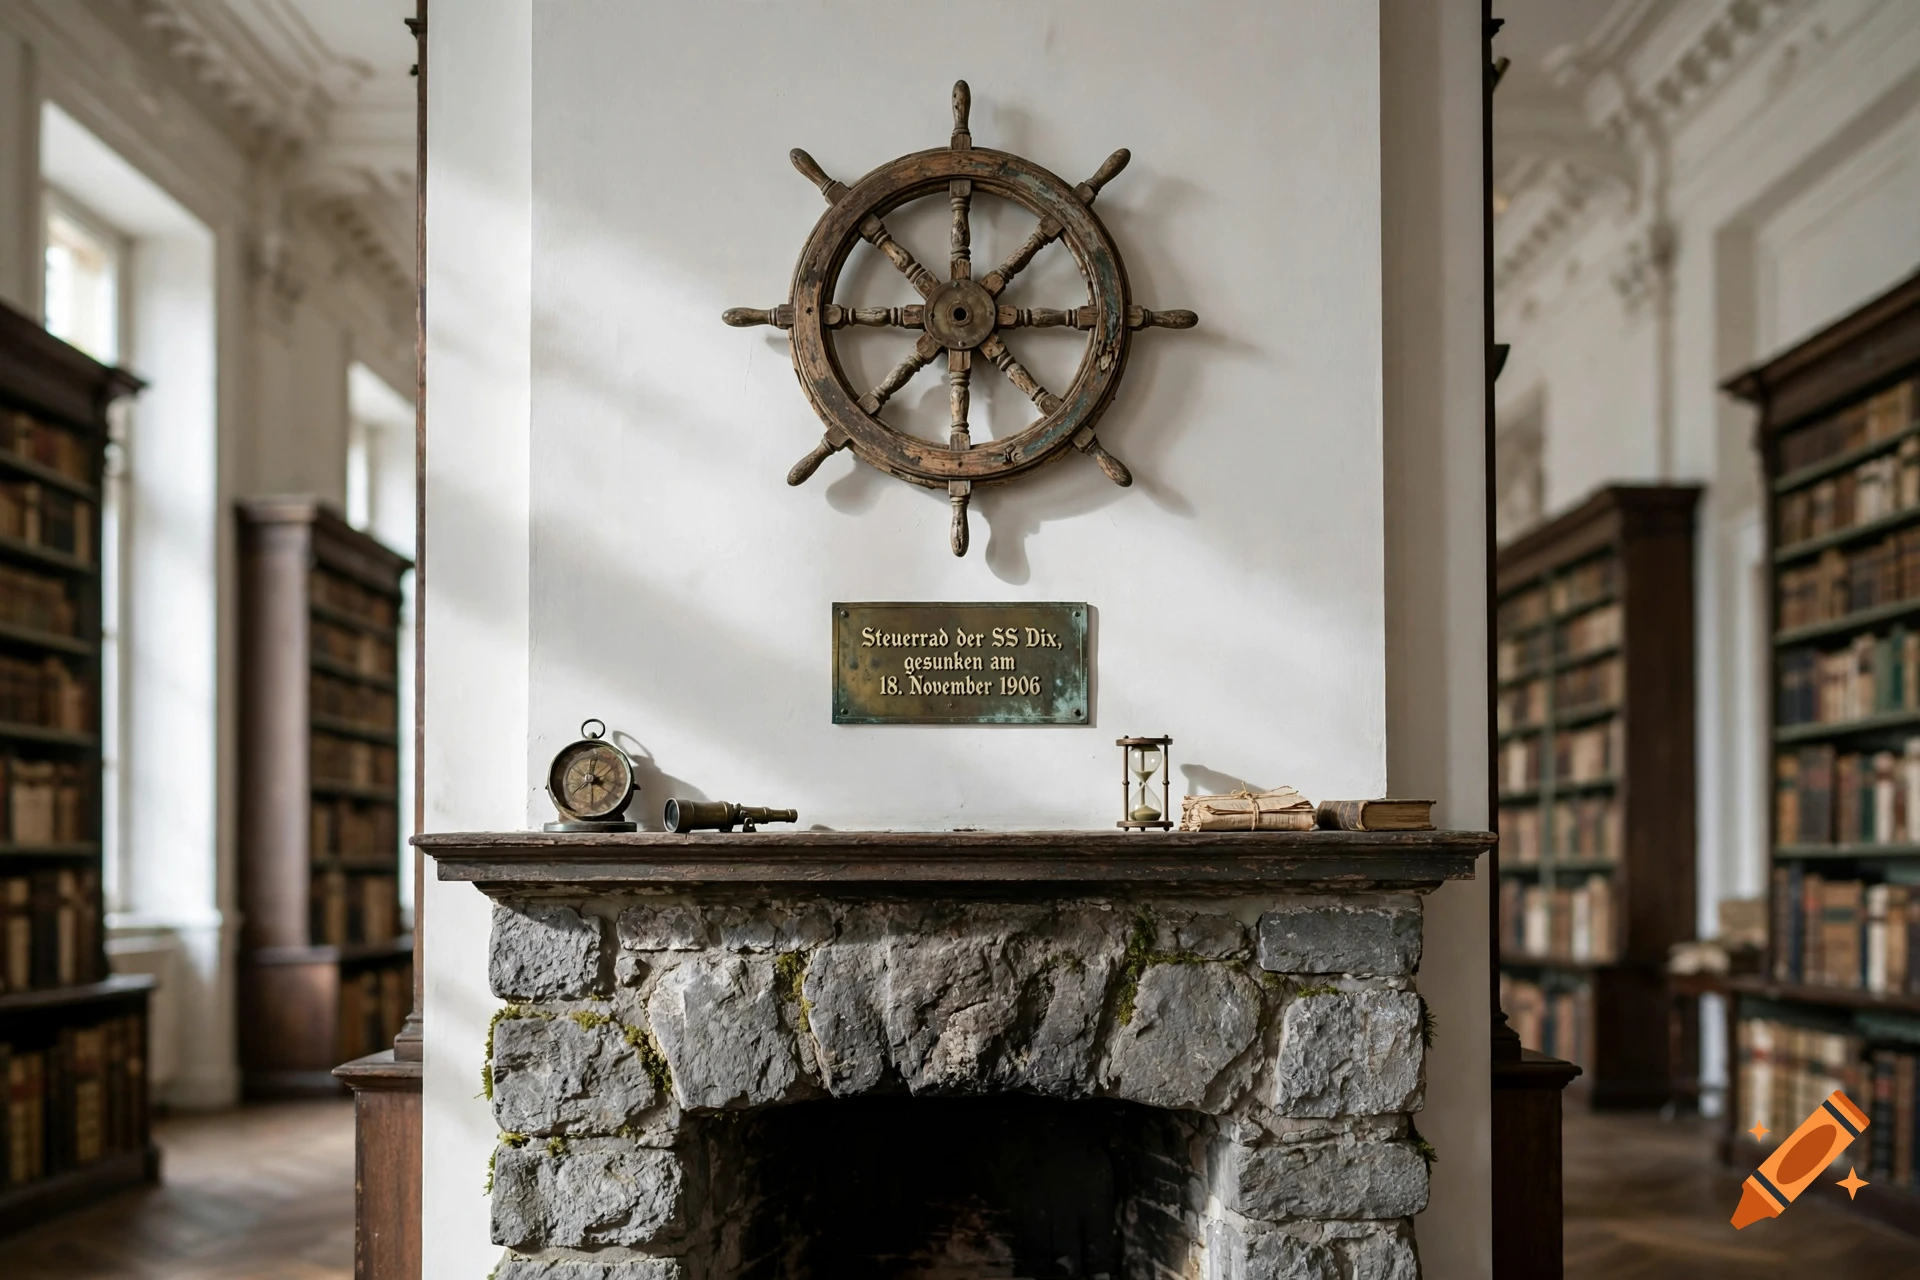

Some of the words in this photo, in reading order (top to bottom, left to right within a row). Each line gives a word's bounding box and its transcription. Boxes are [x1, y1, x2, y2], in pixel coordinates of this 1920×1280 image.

[861, 627, 949, 647] Steuerrad
[956, 627, 984, 647] der
[991, 627, 1019, 647] SS
[1025, 627, 1063, 650] Dix,
[904, 651, 983, 675] gesunken
[990, 655, 1015, 671] am
[879, 675, 903, 695] 18.
[909, 674, 993, 695] November
[1000, 675, 1041, 695] 1906
